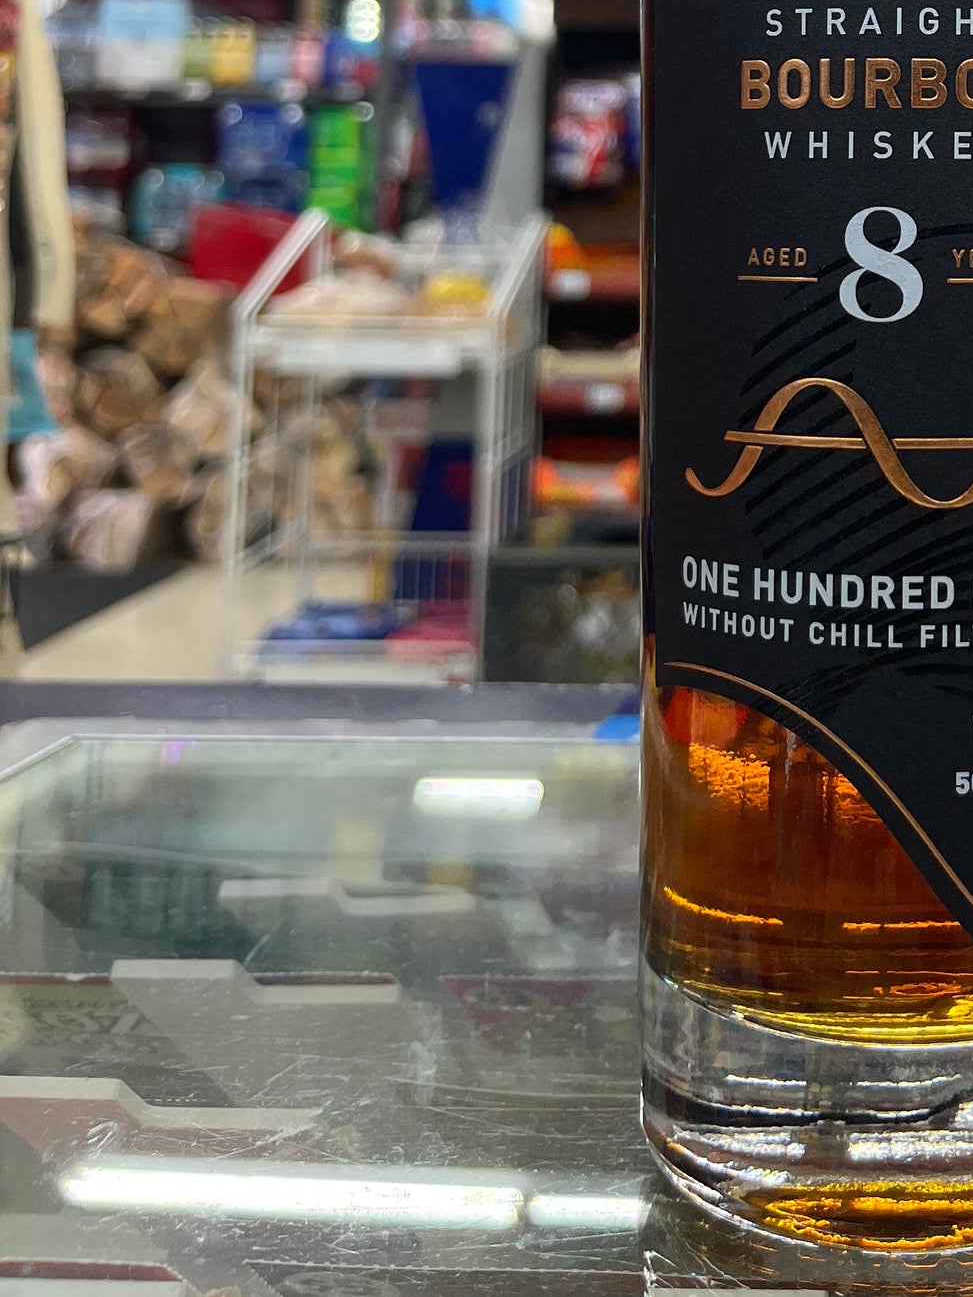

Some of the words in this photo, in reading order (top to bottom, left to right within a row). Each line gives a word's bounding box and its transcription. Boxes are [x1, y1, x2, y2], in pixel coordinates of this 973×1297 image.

[747, 246, 809, 268] AGED
[838, 205, 925, 324] 8
[682, 555, 741, 597] ONE
[752, 567, 956, 610] HUNDRED
[682, 601, 796, 642] WITHOUT
[808, 620, 904, 648] CHILL
